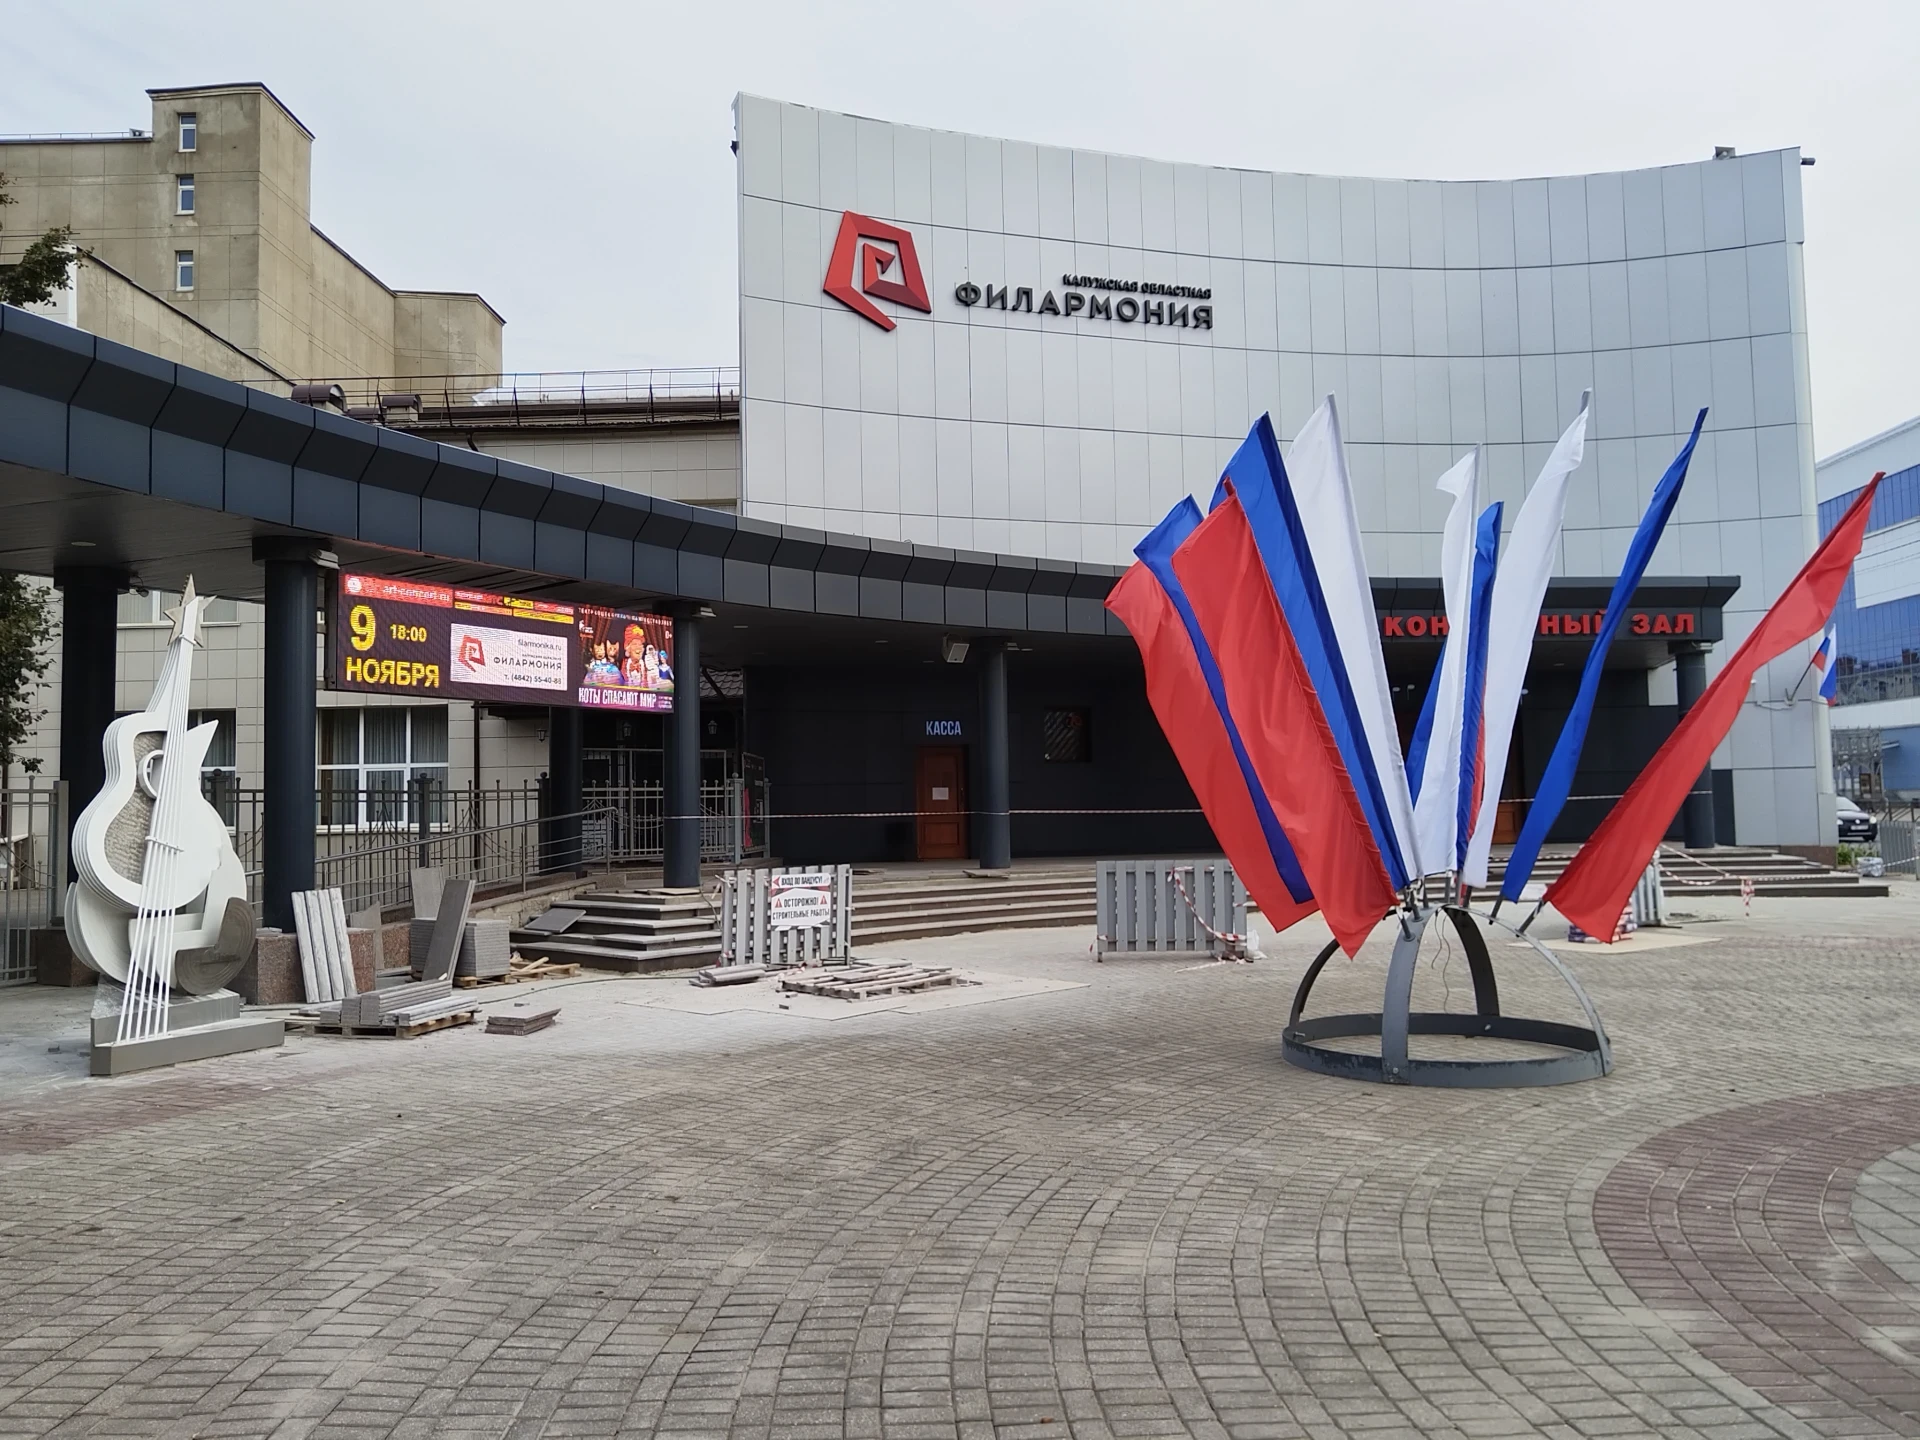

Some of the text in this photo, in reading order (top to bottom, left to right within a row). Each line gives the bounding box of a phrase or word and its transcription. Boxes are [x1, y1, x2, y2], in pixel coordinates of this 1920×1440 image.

[1063, 274, 1212, 300] КАЛУЖСКАЯ ОБЛАСТНАЯ
[955, 282, 1213, 329] ФИЛАРМОНИЯ
[350, 605, 376, 651] 9
[1384, 609, 1695, 637] КОННЫ ЗАЛ
[390, 624, 427, 642] 18:00
[518, 639, 562, 651] filarmonika.ru
[493, 656, 562, 670] ФИЛАРМОНИЯ
[346, 656, 439, 688] НОЯБРЯ
[511, 673, 533, 683] (4842)
[578, 687, 601, 704] КОТЫ
[602, 689, 639, 707] СПАСАЮТ
[640, 692, 657, 708] МИР
[926, 721, 962, 735] КАССА
[781, 877, 793, 886] ВХОД
[784, 897, 819, 908] ОСТОРОЖНО!
[773, 908, 829, 920] СТРОИТЕЛЬНЫЕ РАБОТЫ
